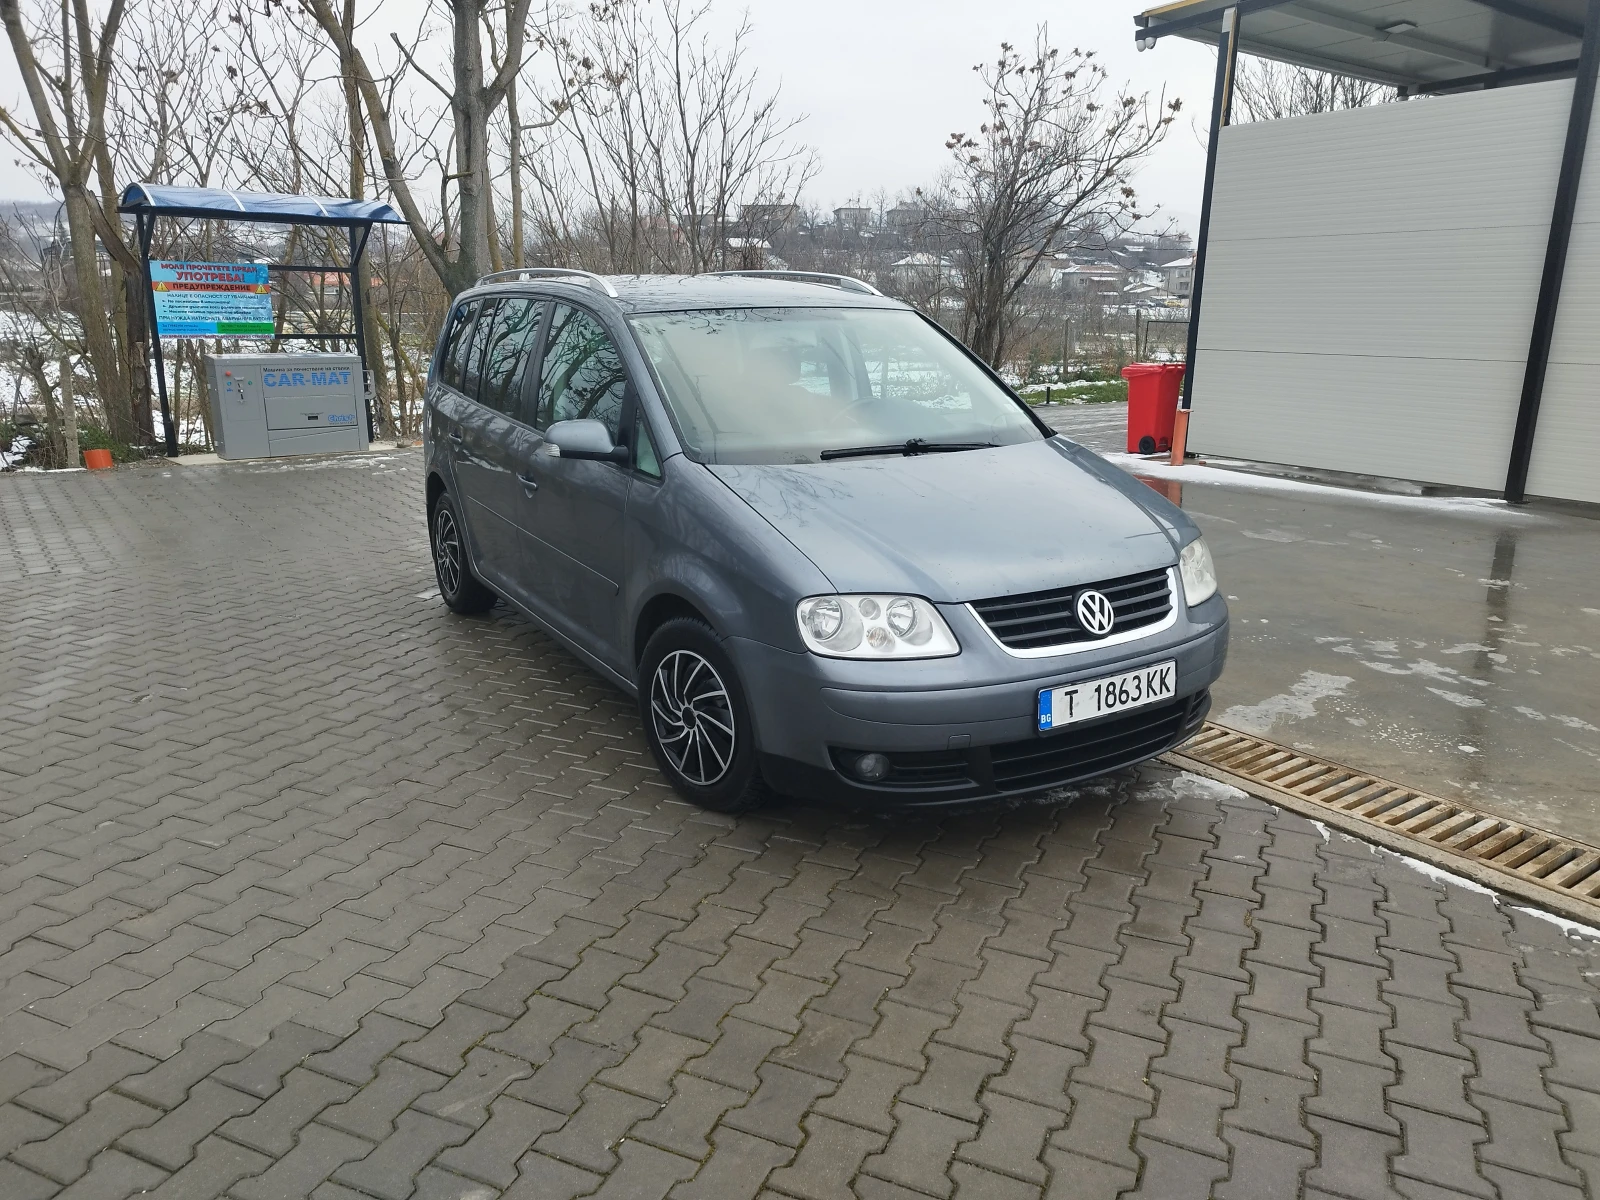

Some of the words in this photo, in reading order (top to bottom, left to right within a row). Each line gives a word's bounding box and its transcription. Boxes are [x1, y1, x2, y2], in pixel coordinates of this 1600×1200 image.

[186, 264, 230, 272] ПРОЧЕТЕТЕ
[232, 265, 257, 273] ПРЕДИ
[176, 271, 245, 282] УПОТРЕБА!
[173, 283, 251, 291] ПРЕДУПРЕЖДЕНИЕ
[263, 371, 351, 387] CAR-MAT
[1064, 689, 1079, 718] T
[1040, 713, 1052, 724] BG
